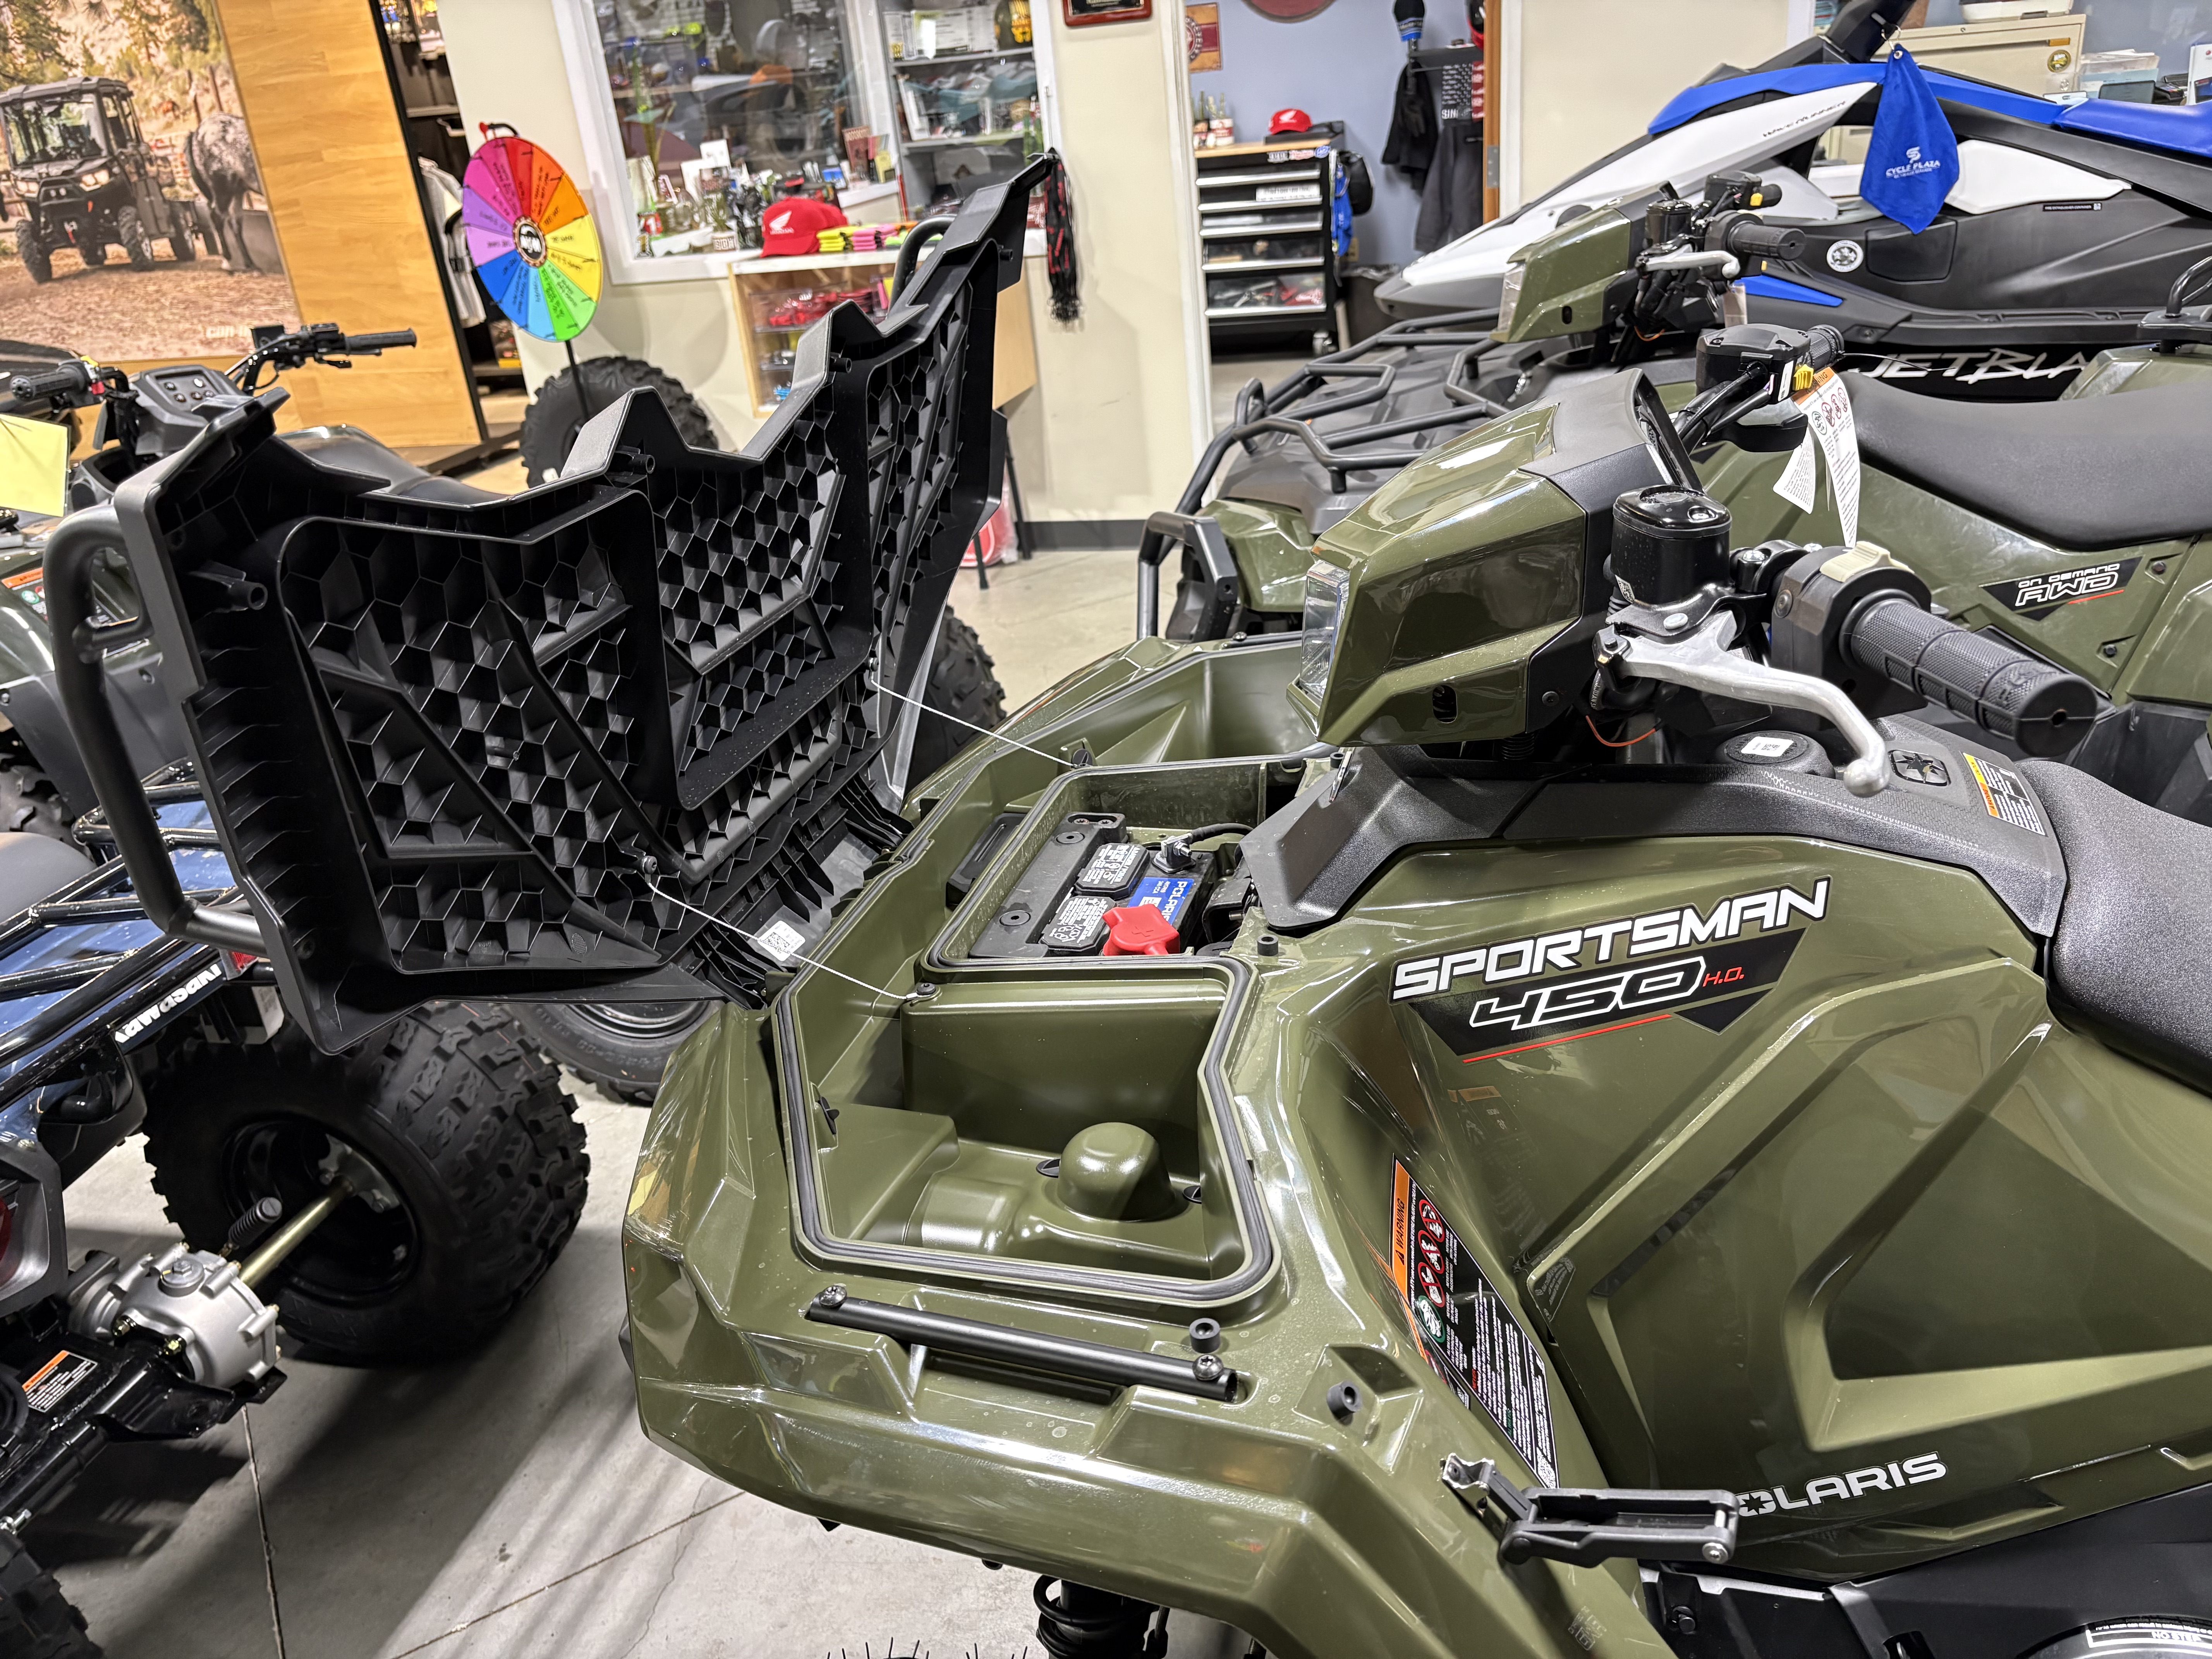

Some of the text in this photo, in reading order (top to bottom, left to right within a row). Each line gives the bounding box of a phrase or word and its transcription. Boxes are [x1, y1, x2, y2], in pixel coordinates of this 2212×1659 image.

[1886, 164, 1911, 177] CYCLE
[1913, 160, 1941, 169] PLAZA
[1848, 348, 2091, 384] JETBLA
[2015, 571, 2119, 606] AWD
[1393, 879, 1829, 1000] SPORTSMAN
[1469, 956, 1745, 1031] 450 H.O.
[1396, 1198, 1405, 1249] WARNING
[1738, 1452, 1946, 1516] OLARIS
